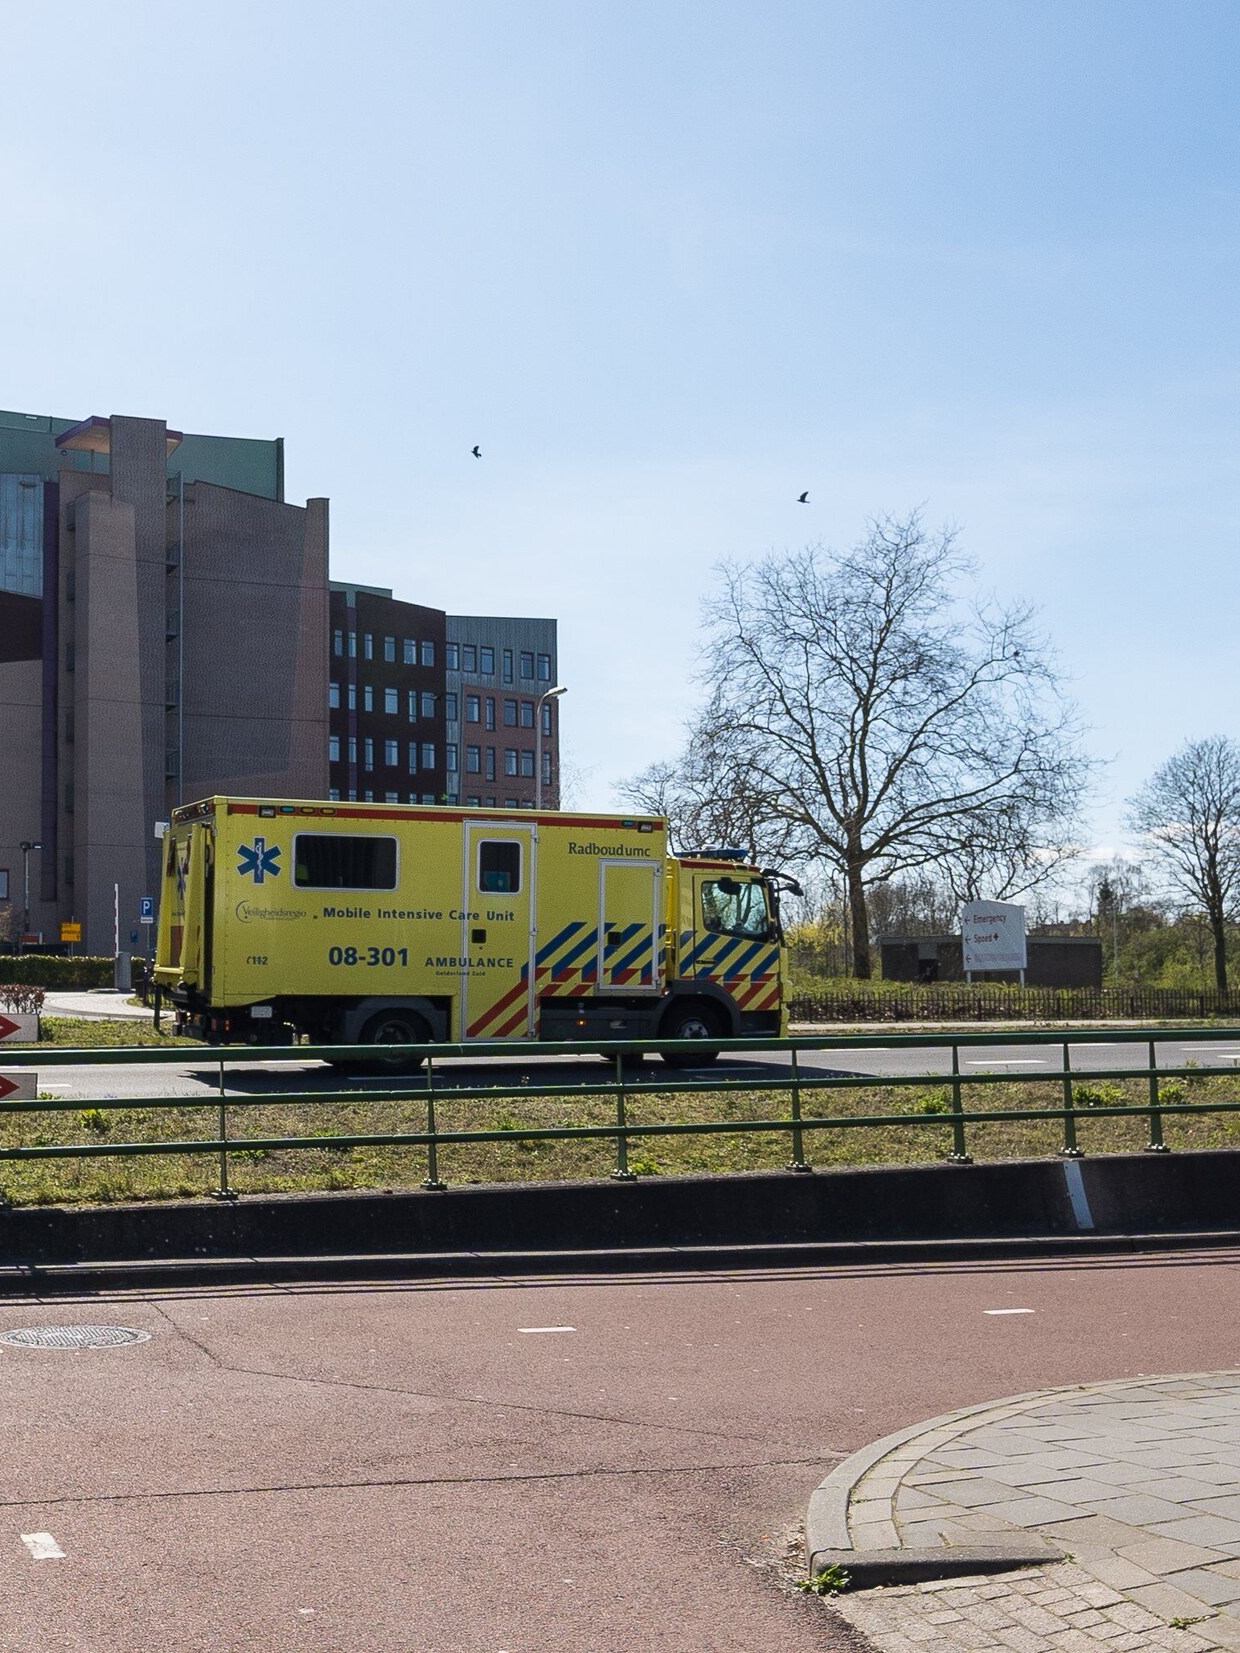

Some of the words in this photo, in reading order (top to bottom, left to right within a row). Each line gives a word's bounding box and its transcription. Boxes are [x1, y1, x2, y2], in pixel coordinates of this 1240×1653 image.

[568, 842, 651, 857] Radboudumc
[143, 901, 151, 915] P
[323, 907, 371, 918] Mobile
[378, 909, 443, 920] Intensive
[449, 910, 480, 920] Care
[487, 911, 515, 921] Unit
[973, 915, 1007, 924] Emergency
[328, 946, 408, 967] 08-301
[424, 957, 514, 968] AMBULANCE
